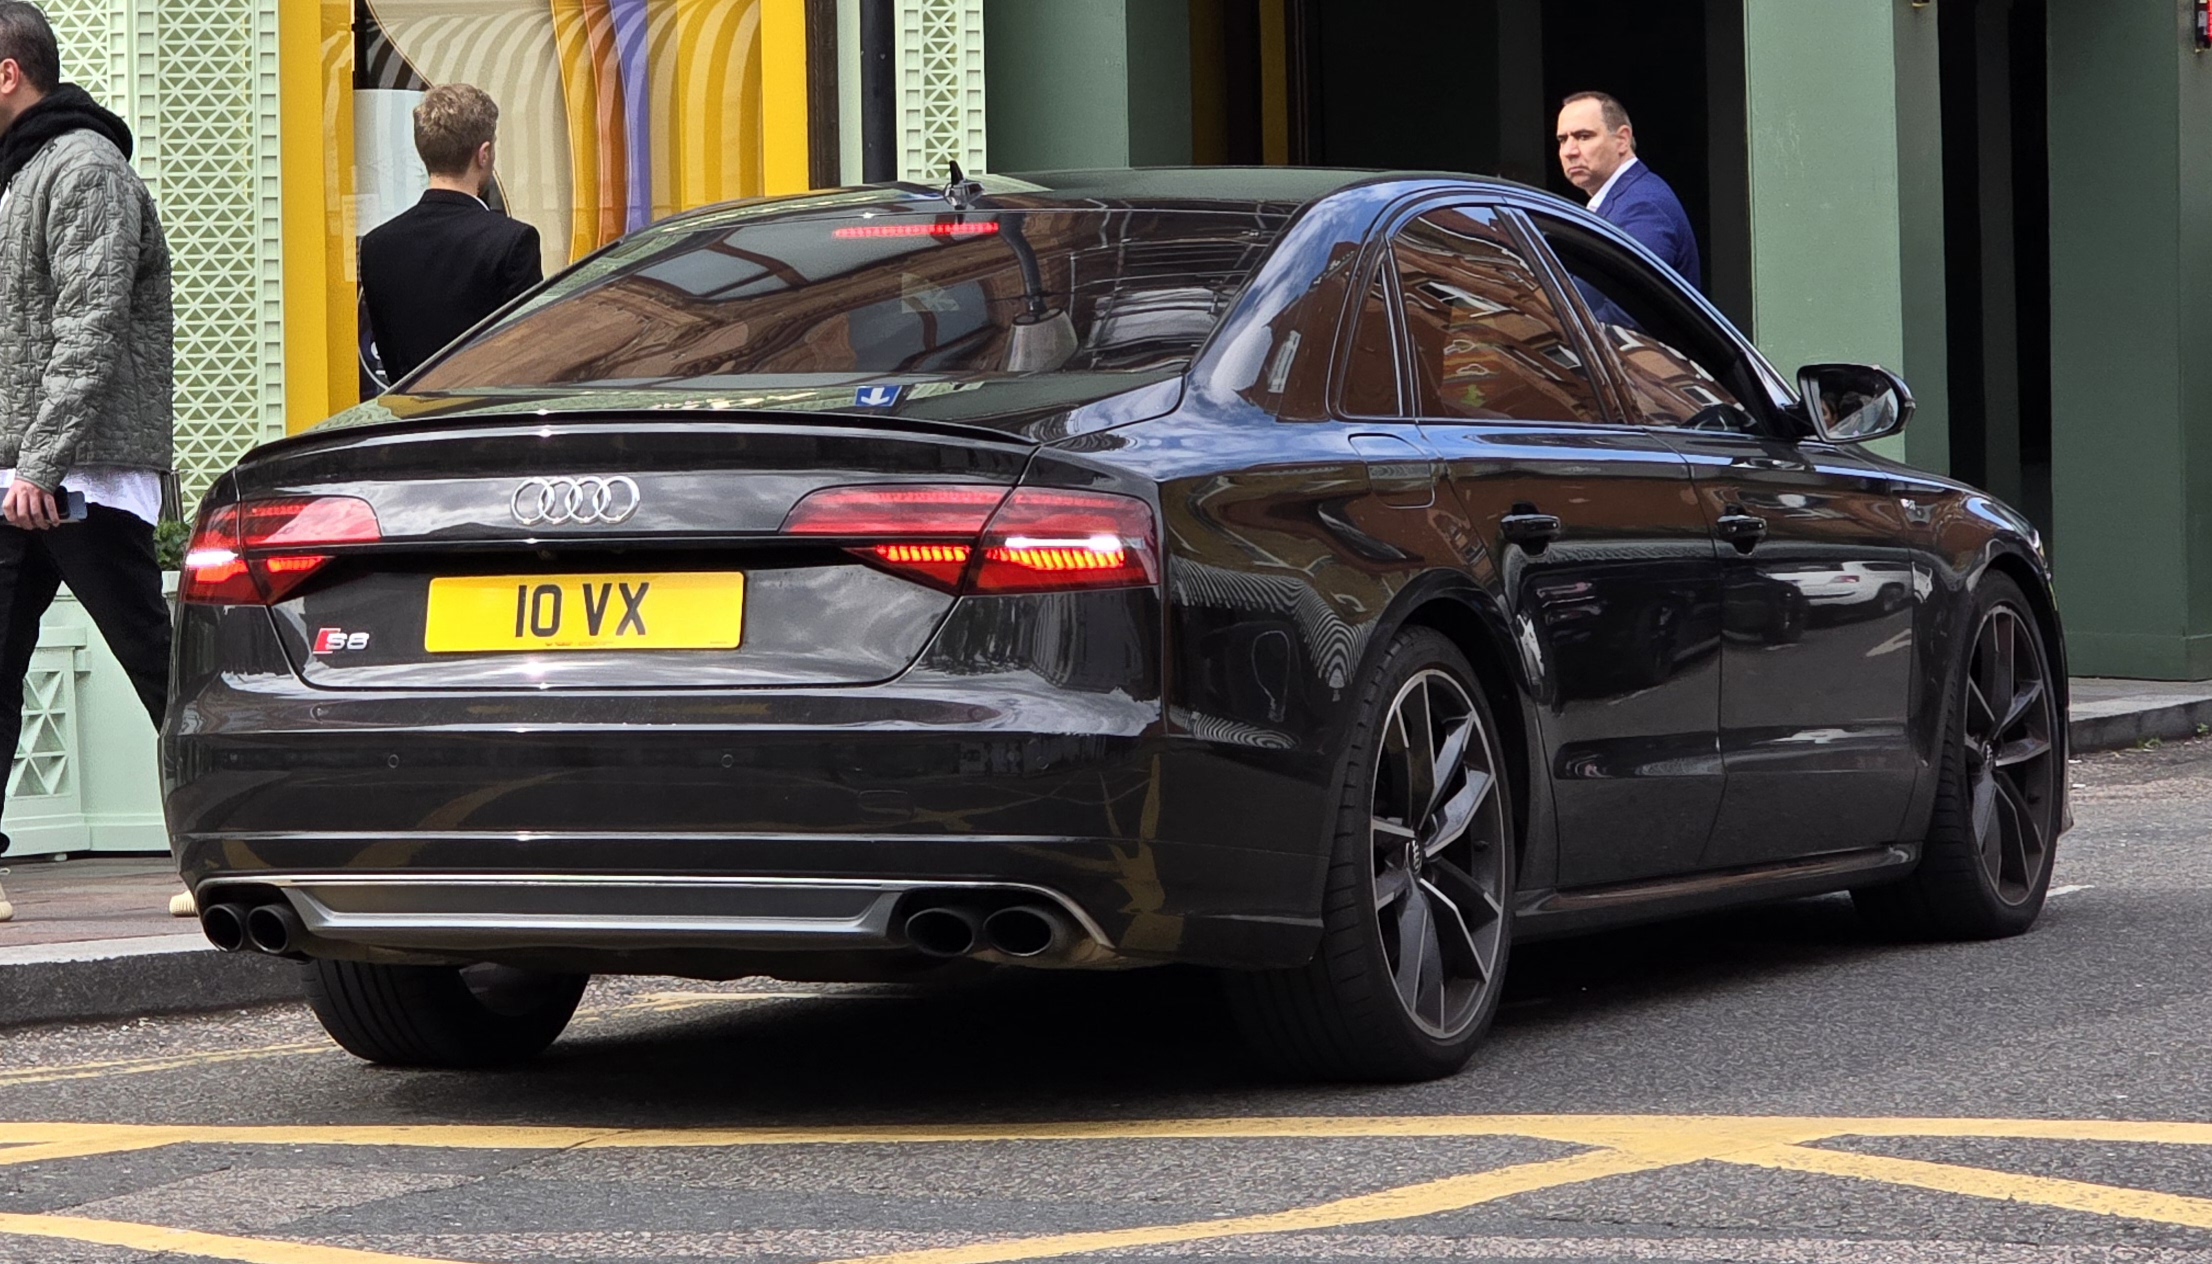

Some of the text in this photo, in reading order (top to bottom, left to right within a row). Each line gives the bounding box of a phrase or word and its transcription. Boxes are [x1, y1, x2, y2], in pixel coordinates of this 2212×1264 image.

[515, 582, 650, 638] 10 VX
[325, 632, 370, 650] S8
